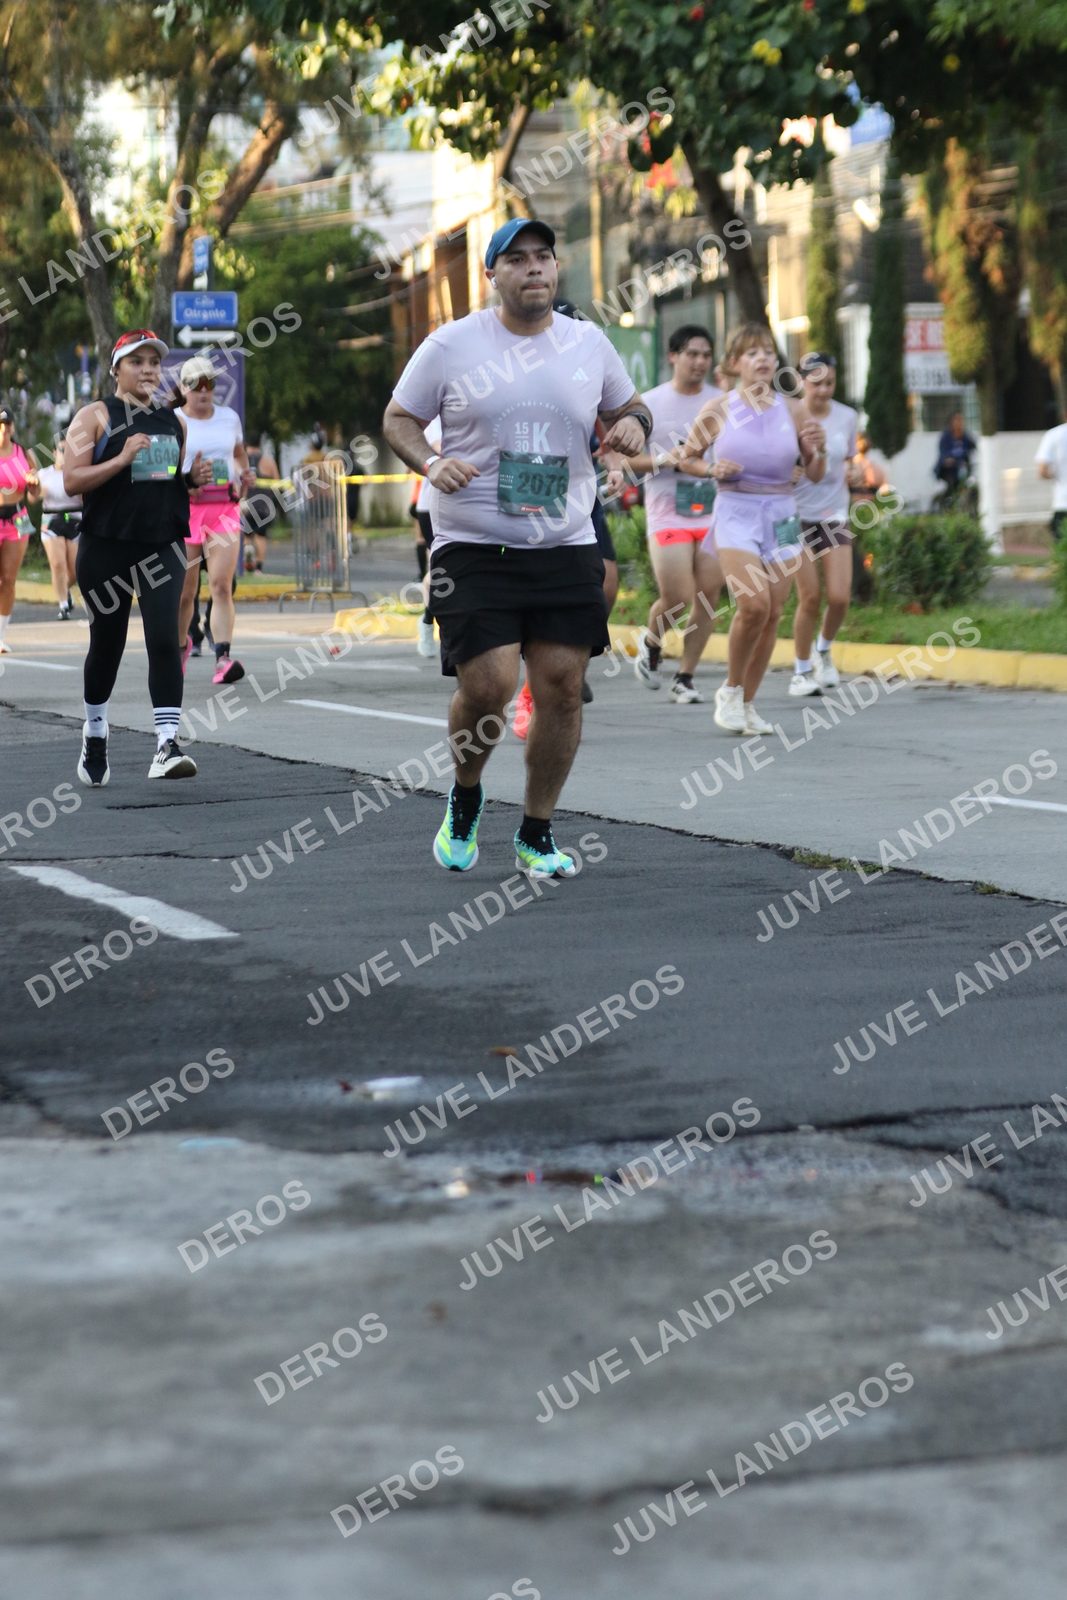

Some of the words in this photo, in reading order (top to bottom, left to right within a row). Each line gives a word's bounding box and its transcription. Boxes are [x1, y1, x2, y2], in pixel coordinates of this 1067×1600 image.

[514, 422, 529, 435] 15
[532, 422, 551, 453] K
[514, 440, 529, 453] 30
